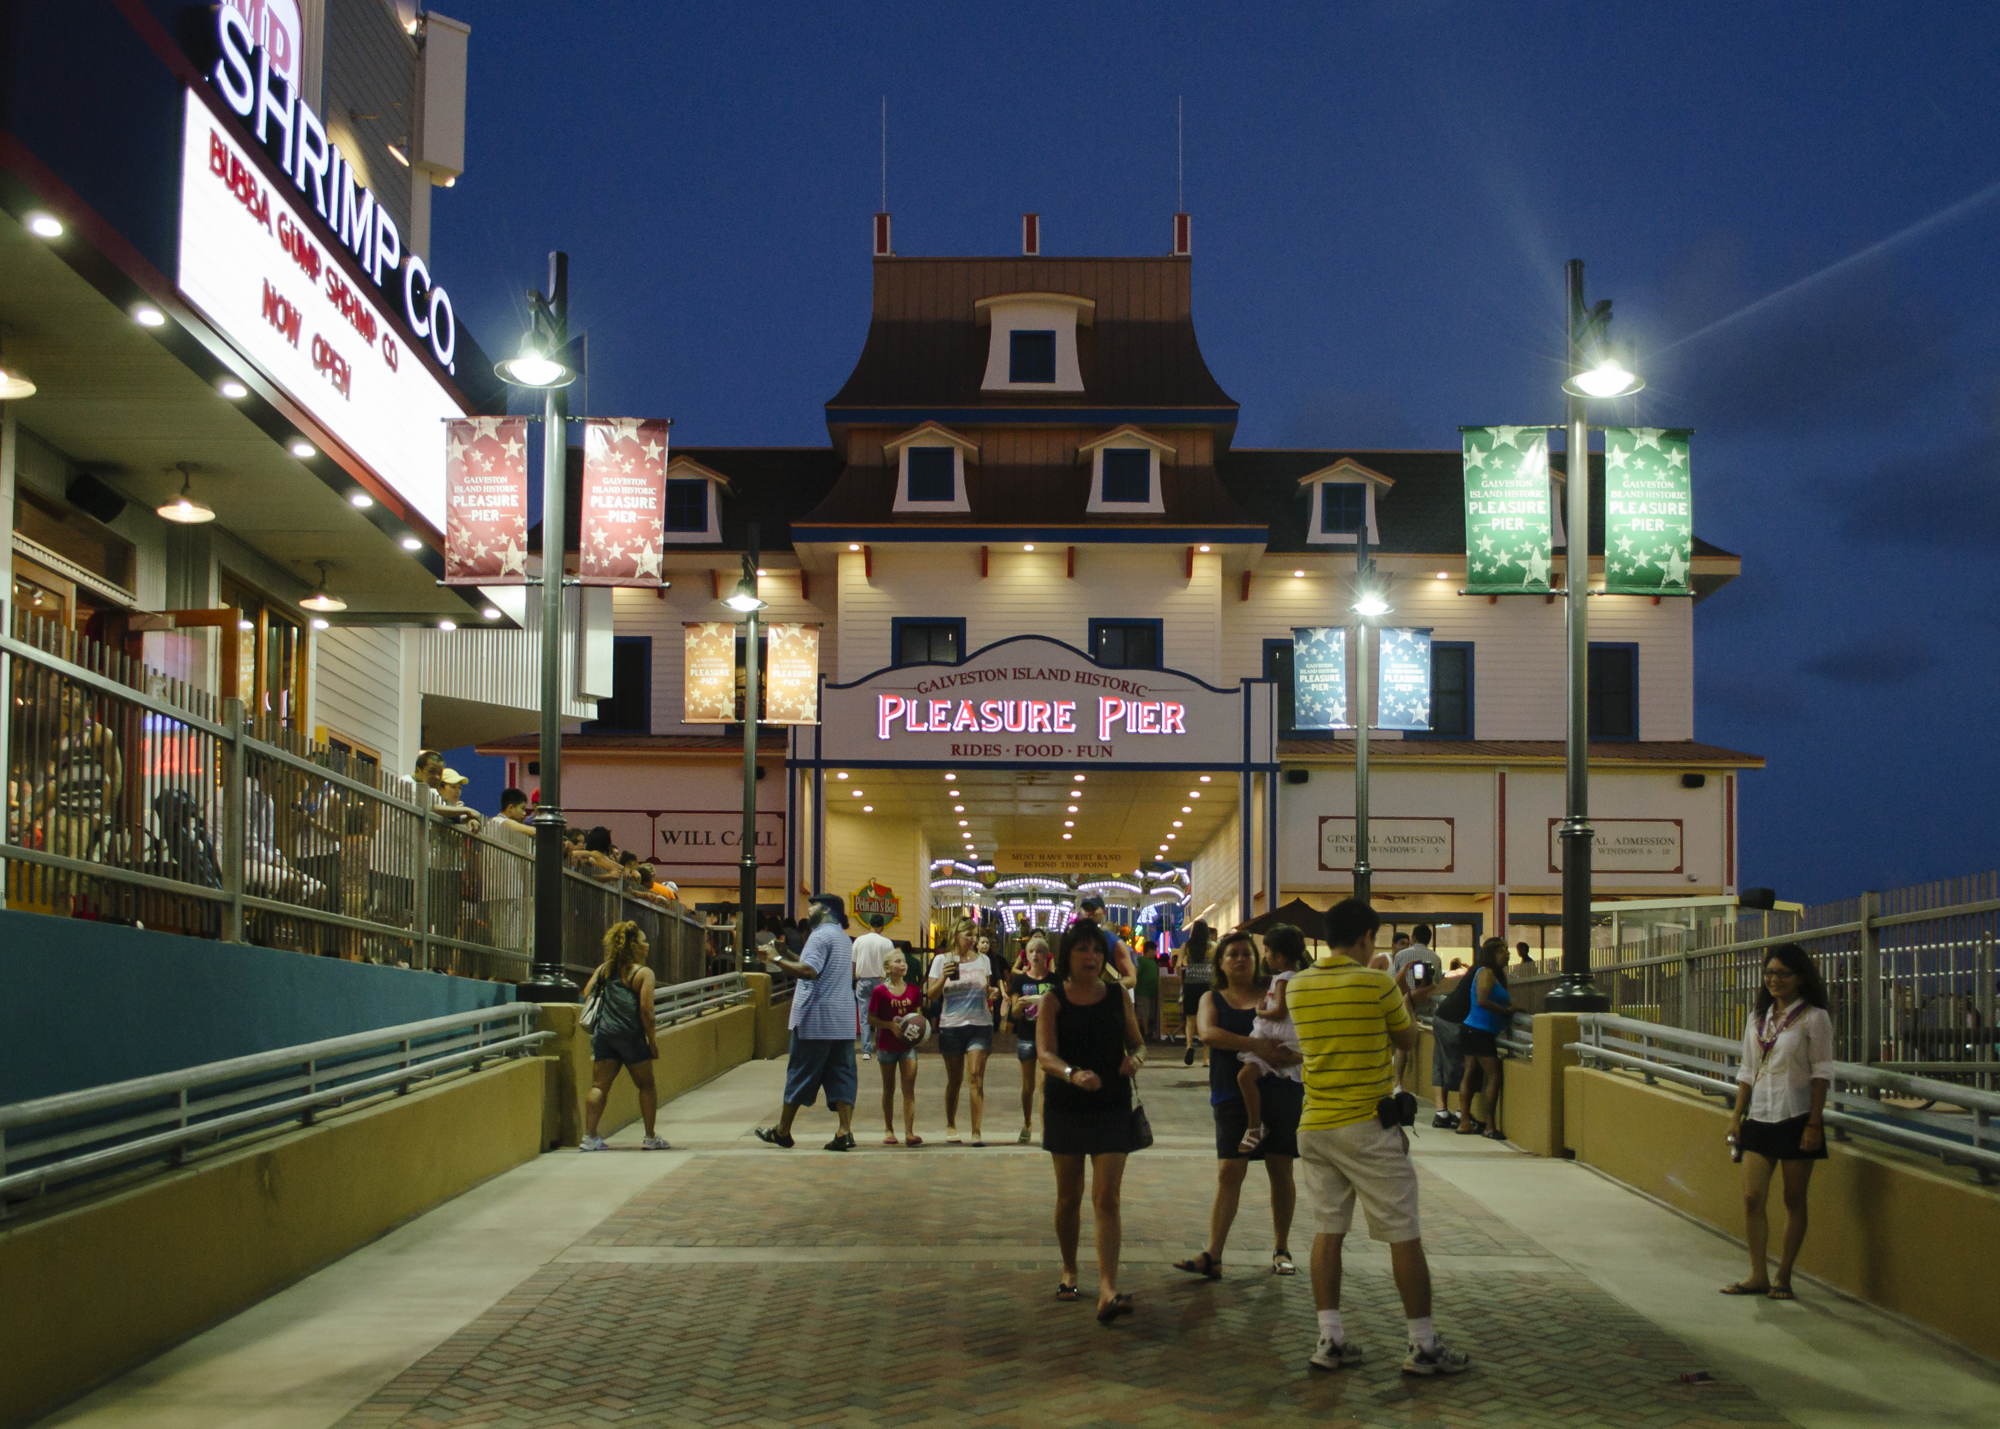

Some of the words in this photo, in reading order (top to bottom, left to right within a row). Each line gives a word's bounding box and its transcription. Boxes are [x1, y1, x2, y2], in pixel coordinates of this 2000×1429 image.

[214, 3, 401, 287] SHRIMP
[405, 255, 456, 377] CO.
[208, 126, 275, 239] BUBBA
[277, 210, 323, 286] GUMP
[324, 264, 379, 349] SHRIMP
[381, 331, 399, 374] CO
[261, 276, 304, 351] NOW
[310, 332, 352, 402] OPEN
[463, 476, 508, 484] GALVESTON
[602, 477, 647, 486] GALVESTON
[1481, 480, 1533, 488] GALVESTON
[1622, 480, 1674, 489] GALVESTON
[454, 485, 482, 493] ISLAND
[482, 485, 518, 493] HISTORIC
[592, 486, 621, 494] ISLAND
[621, 487, 657, 495] HISTORIC
[1469, 491, 1503, 499] ISLAND
[1504, 490, 1545, 499] HISTORIC
[1610, 490, 1644, 499] ISLAND
[1645, 491, 1687, 500] HISTORIC
[452, 495, 519, 508] PLEASURE
[590, 496, 657, 509] PLEASURE
[1468, 501, 1547, 515] PLEASURE
[1609, 502, 1688, 516] PLEASURE
[470, 510, 500, 522] PIER
[608, 511, 637, 523] PIER
[1491, 518, 1525, 531] PIER
[1631, 518, 1665, 532] PIER
[690, 669, 731, 677] PLEASURE
[772, 670, 813, 678] PLEASURE
[783, 679, 801, 687] PIER
[916, 667, 1008, 694] GALVESTON
[1012, 667, 1072, 682] ISLAND
[1074, 672, 1149, 698] HISTORIC
[1299, 674, 1341, 683] PLEASURE
[1384, 674, 1426, 683] PLEASURE
[1311, 683, 1329, 691] PIER
[1395, 683, 1414, 692] PIER
[877, 694, 1077, 740] PLEASURE
[1098, 696, 1187, 741] PIER
[950, 743, 1002, 757] RIDES
[1014, 744, 1064, 757] FOOD
[1076, 745, 1113, 758] FUN
[660, 830, 716, 846] WILL
[1326, 834, 1379, 844] GENEAL
[1385, 836, 1446, 844] ADMISSION
[1615, 837, 1676, 845] ADMISSION
[1598, 847, 1644, 855] WINDOWS
[1083, 861, 1109, 869] POINT
